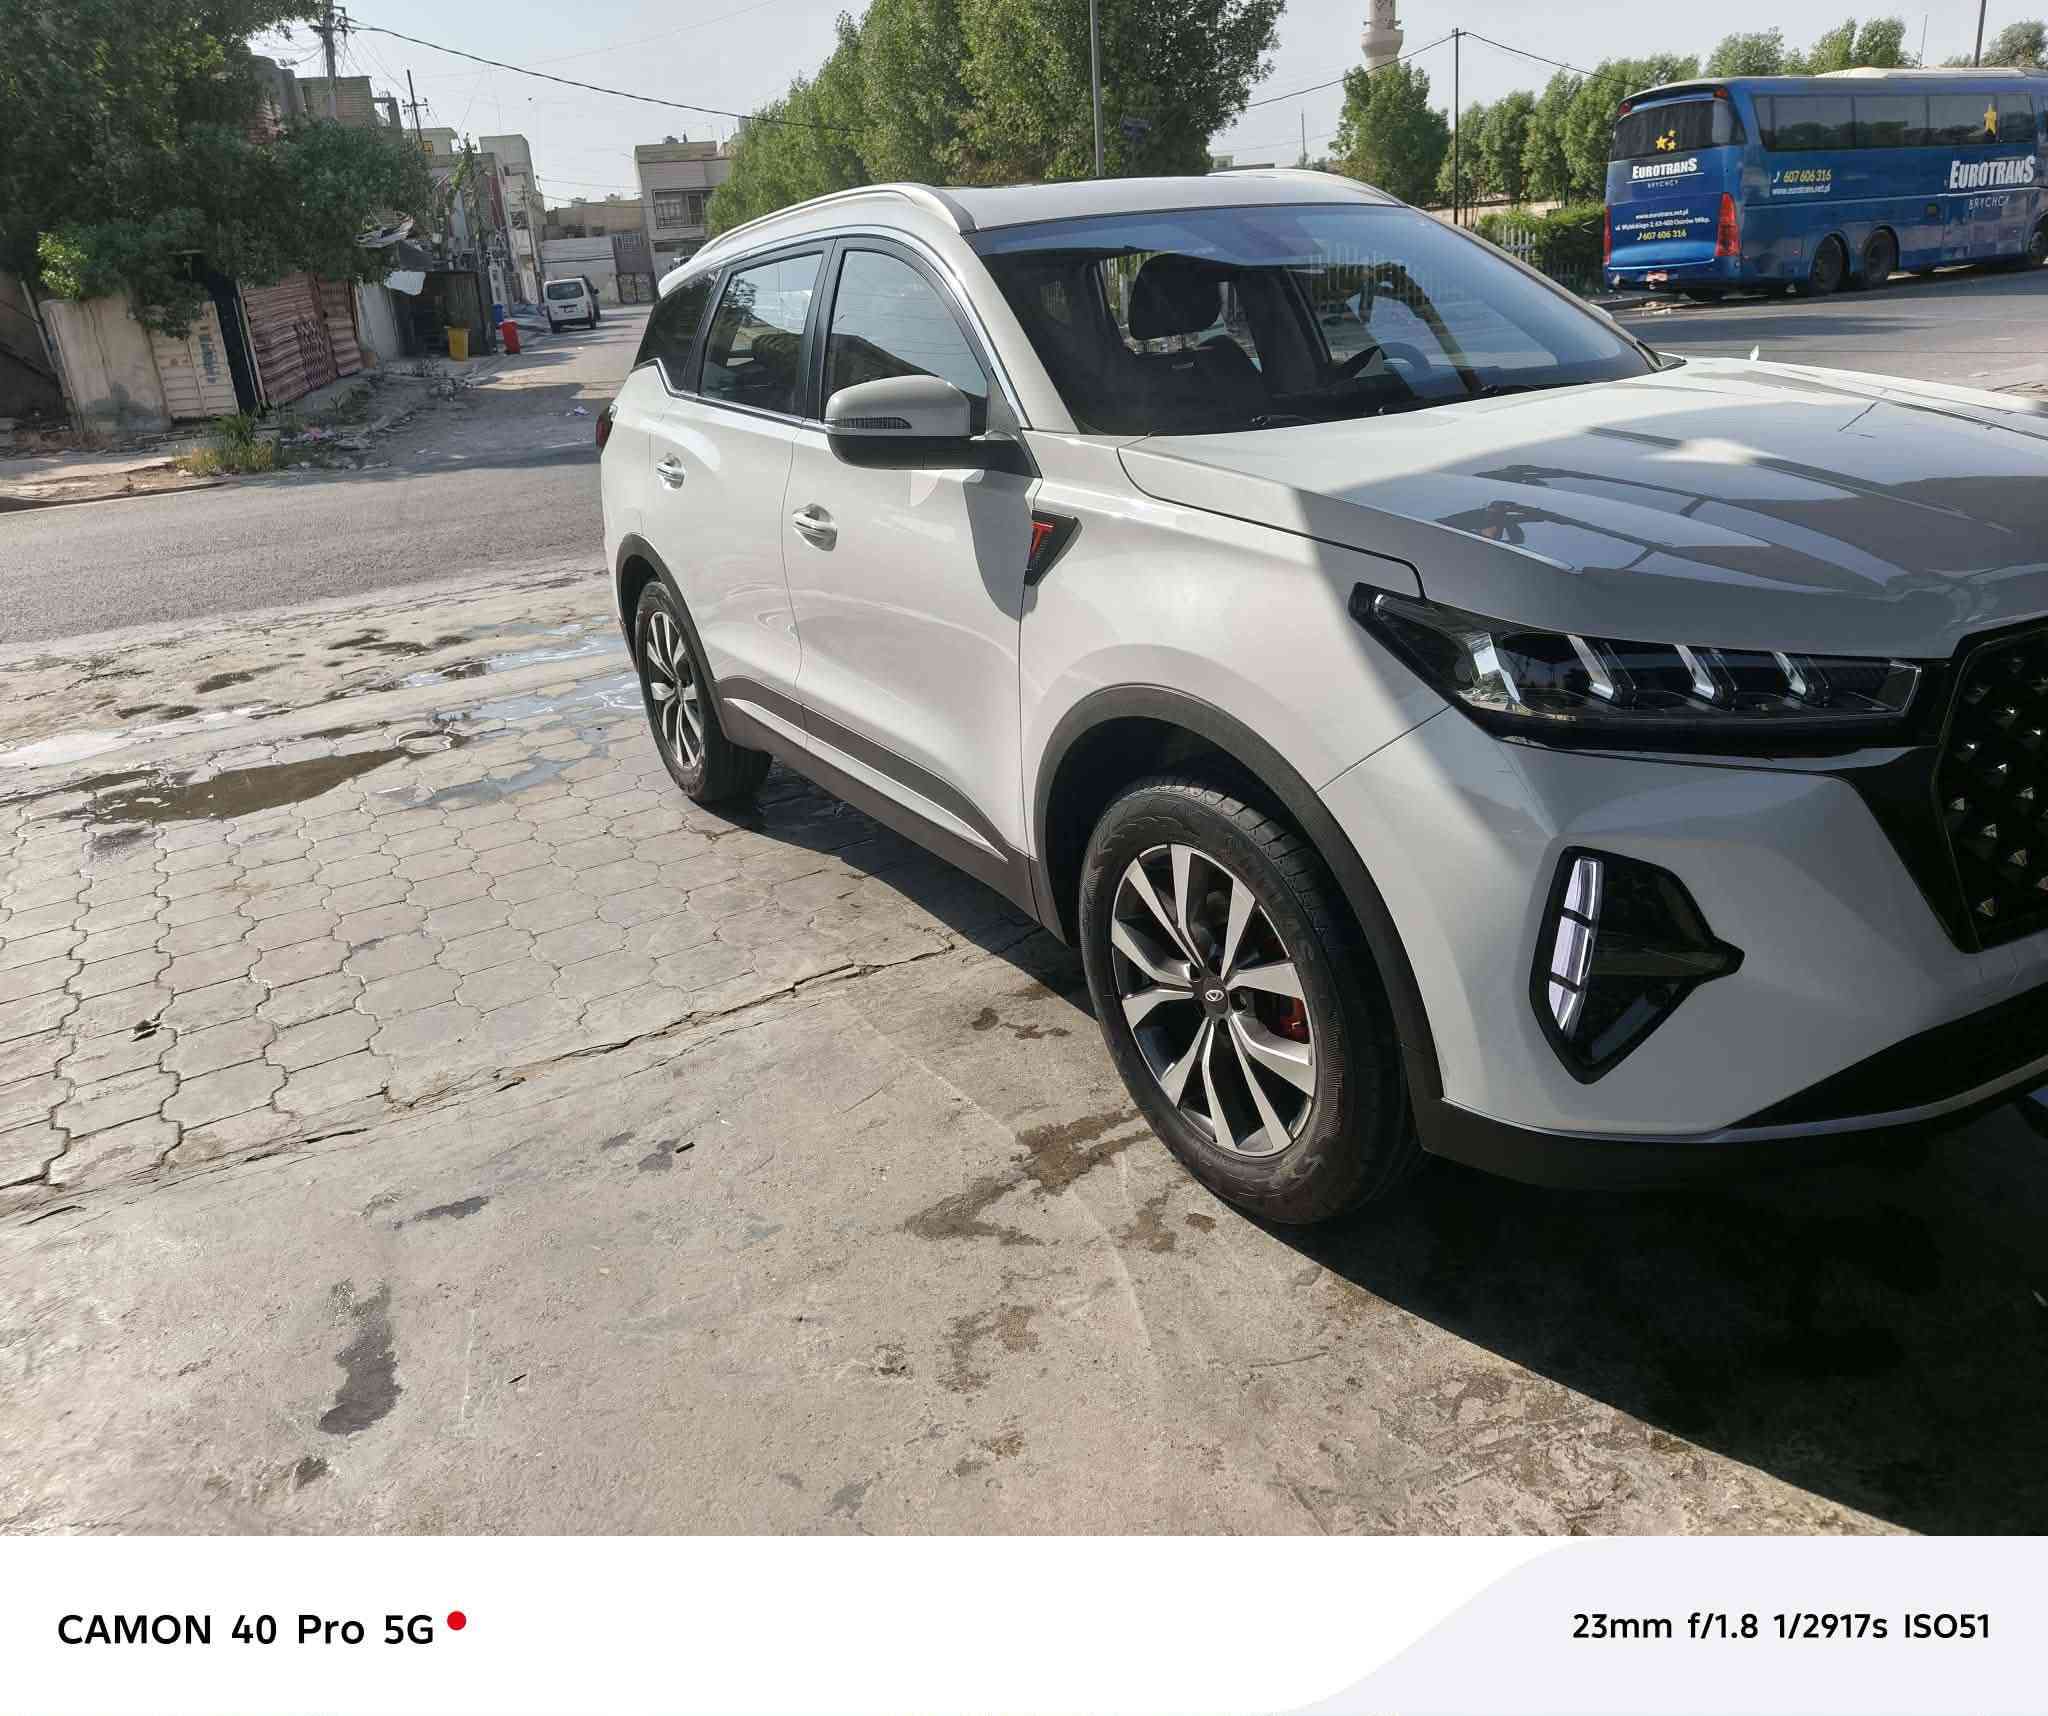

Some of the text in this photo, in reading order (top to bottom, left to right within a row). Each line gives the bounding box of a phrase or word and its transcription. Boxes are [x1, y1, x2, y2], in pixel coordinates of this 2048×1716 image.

[1632, 158, 1697, 179] EUROTRANS
[1949, 155, 2036, 189] EUROTRANS
[1643, 231, 1657, 240] 607
[1672, 229, 1687, 238] 316
